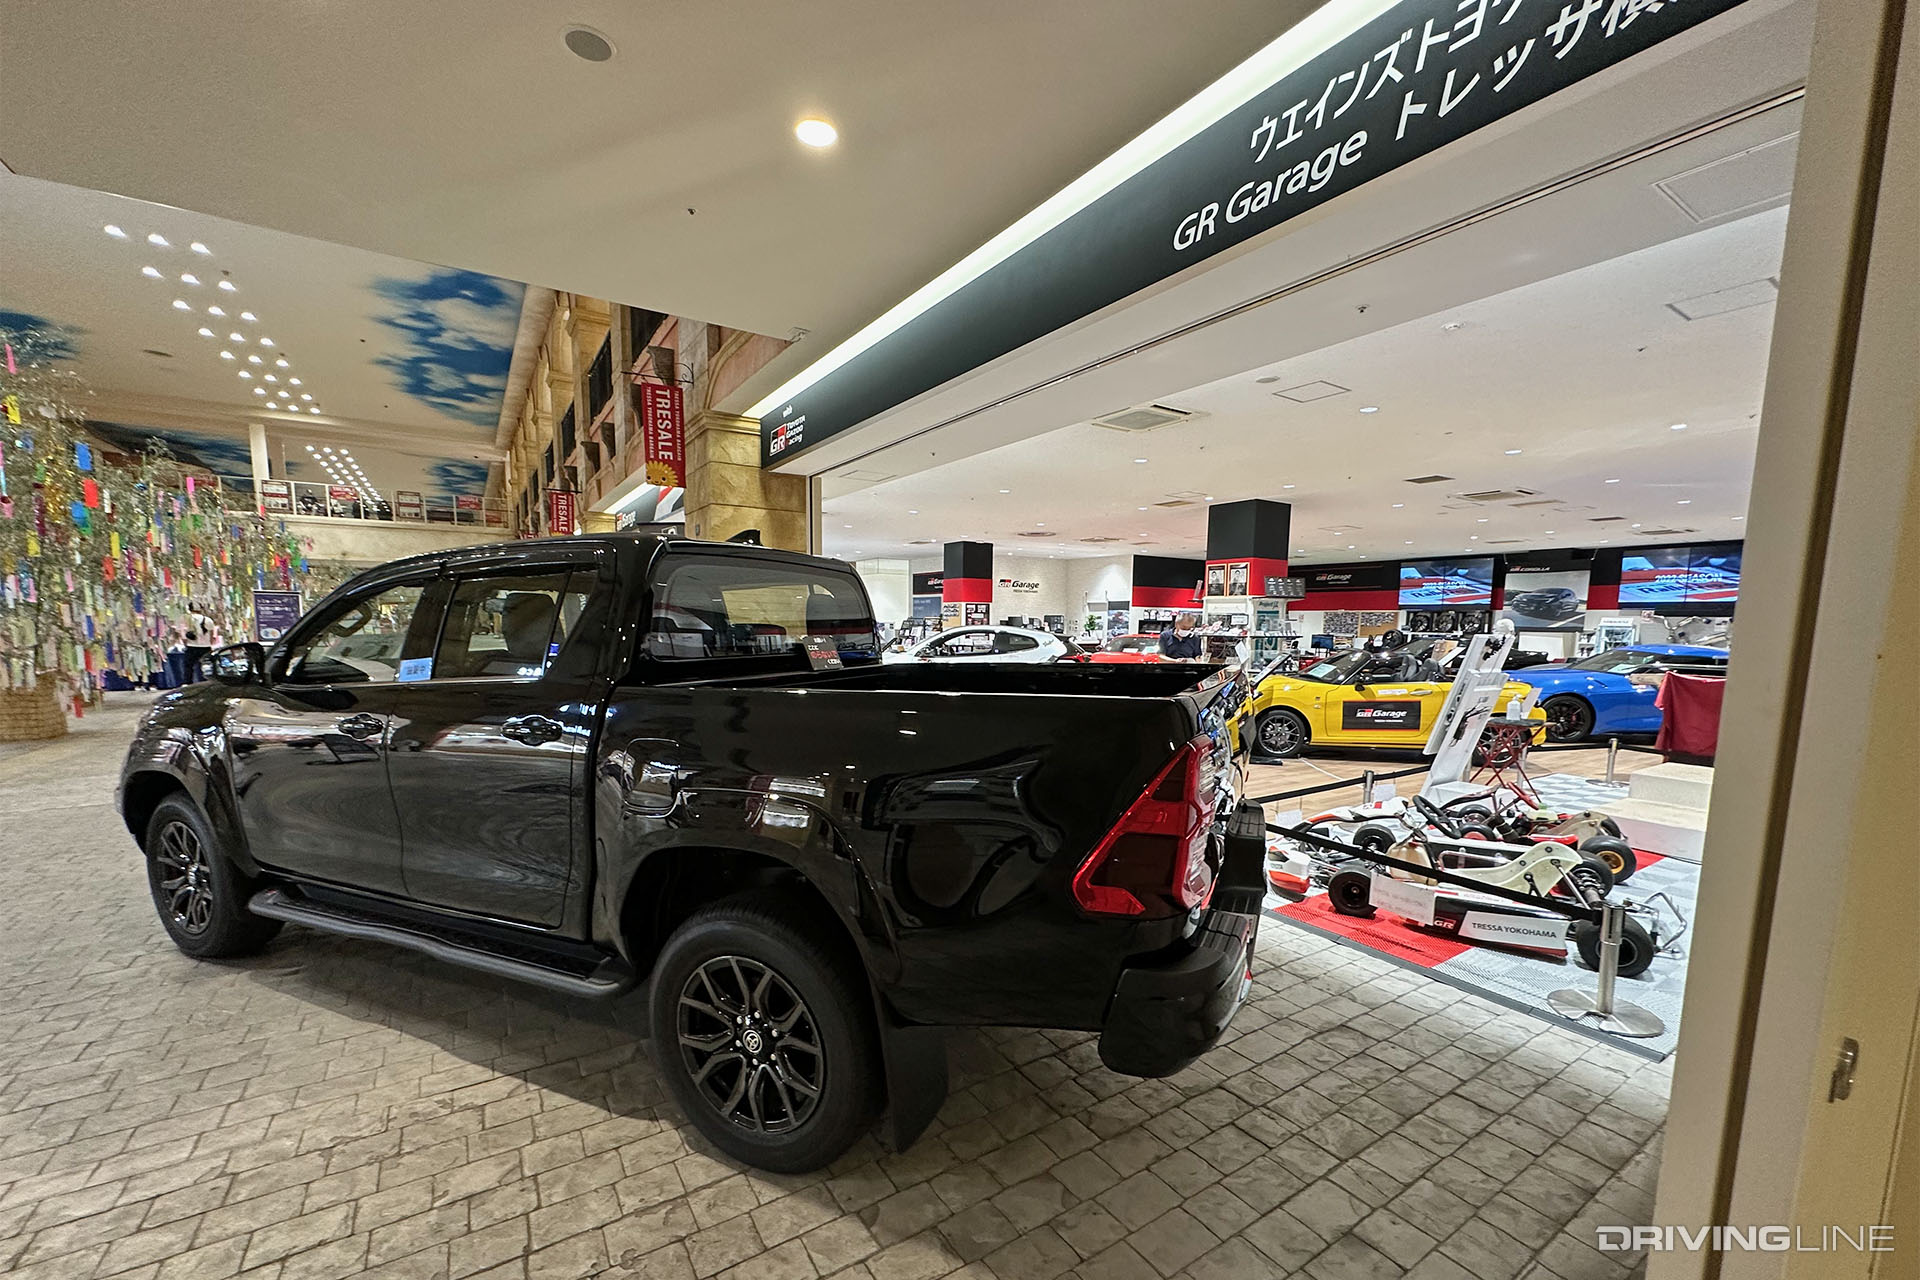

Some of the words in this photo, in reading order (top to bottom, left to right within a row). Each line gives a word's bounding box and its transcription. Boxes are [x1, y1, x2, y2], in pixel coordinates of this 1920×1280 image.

[1173, 202, 1219, 250] GR
[1225, 130, 1368, 224] Garage
[655, 389, 673, 460] TRESALE
[558, 494, 568, 531] TRESALE
[1012, 580, 1040, 589] Garage
[1372, 710, 1408, 719] Garage
[1433, 919, 1455, 929] GR
[1472, 922, 1503, 933] TRESSA
[1503, 926, 1557, 938] YOKOHAMA
